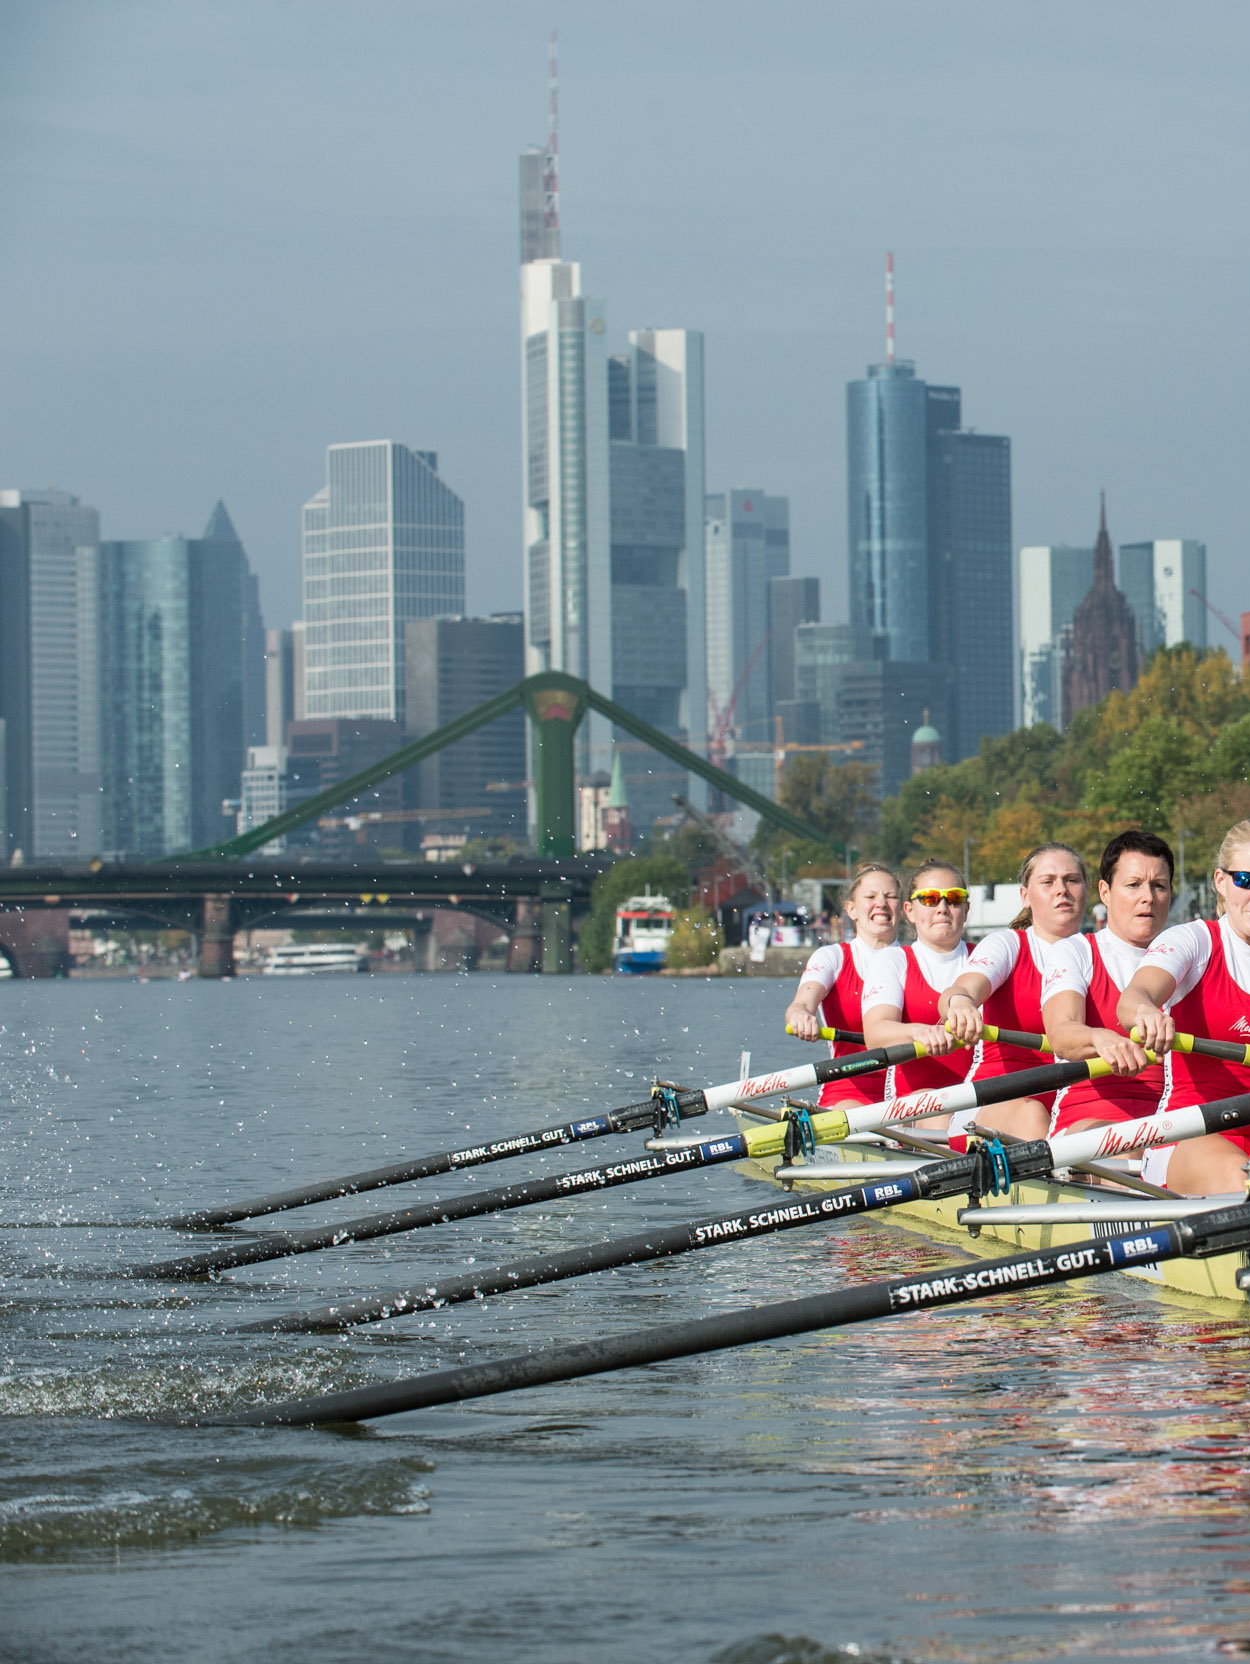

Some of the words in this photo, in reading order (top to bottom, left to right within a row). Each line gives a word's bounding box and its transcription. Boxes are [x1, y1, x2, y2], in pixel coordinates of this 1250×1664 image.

[735, 1072, 790, 1101] Melitta
[880, 1093, 946, 1125] Melitta
[452, 1146, 490, 1163] STARK.
[491, 1135, 541, 1154] SCHNELL.
[541, 1128, 567, 1142] GUT.
[1091, 1121, 1168, 1161] Melitta
[562, 1169, 606, 1188] STARK.
[606, 1157, 665, 1179] SCHNELL.
[666, 1149, 695, 1165] GUT.
[709, 1140, 733, 1153] RBL
[695, 1219, 747, 1241] STARK.
[749, 1204, 820, 1229] SCHNELL.
[821, 1194, 857, 1213] GUT.
[874, 1184, 903, 1199] RBL
[899, 1278, 964, 1304] STARK.
[964, 1260, 1055, 1290] SCHNELL.
[1056, 1248, 1101, 1272] GUT.
[1122, 1236, 1159, 1255] RBL
